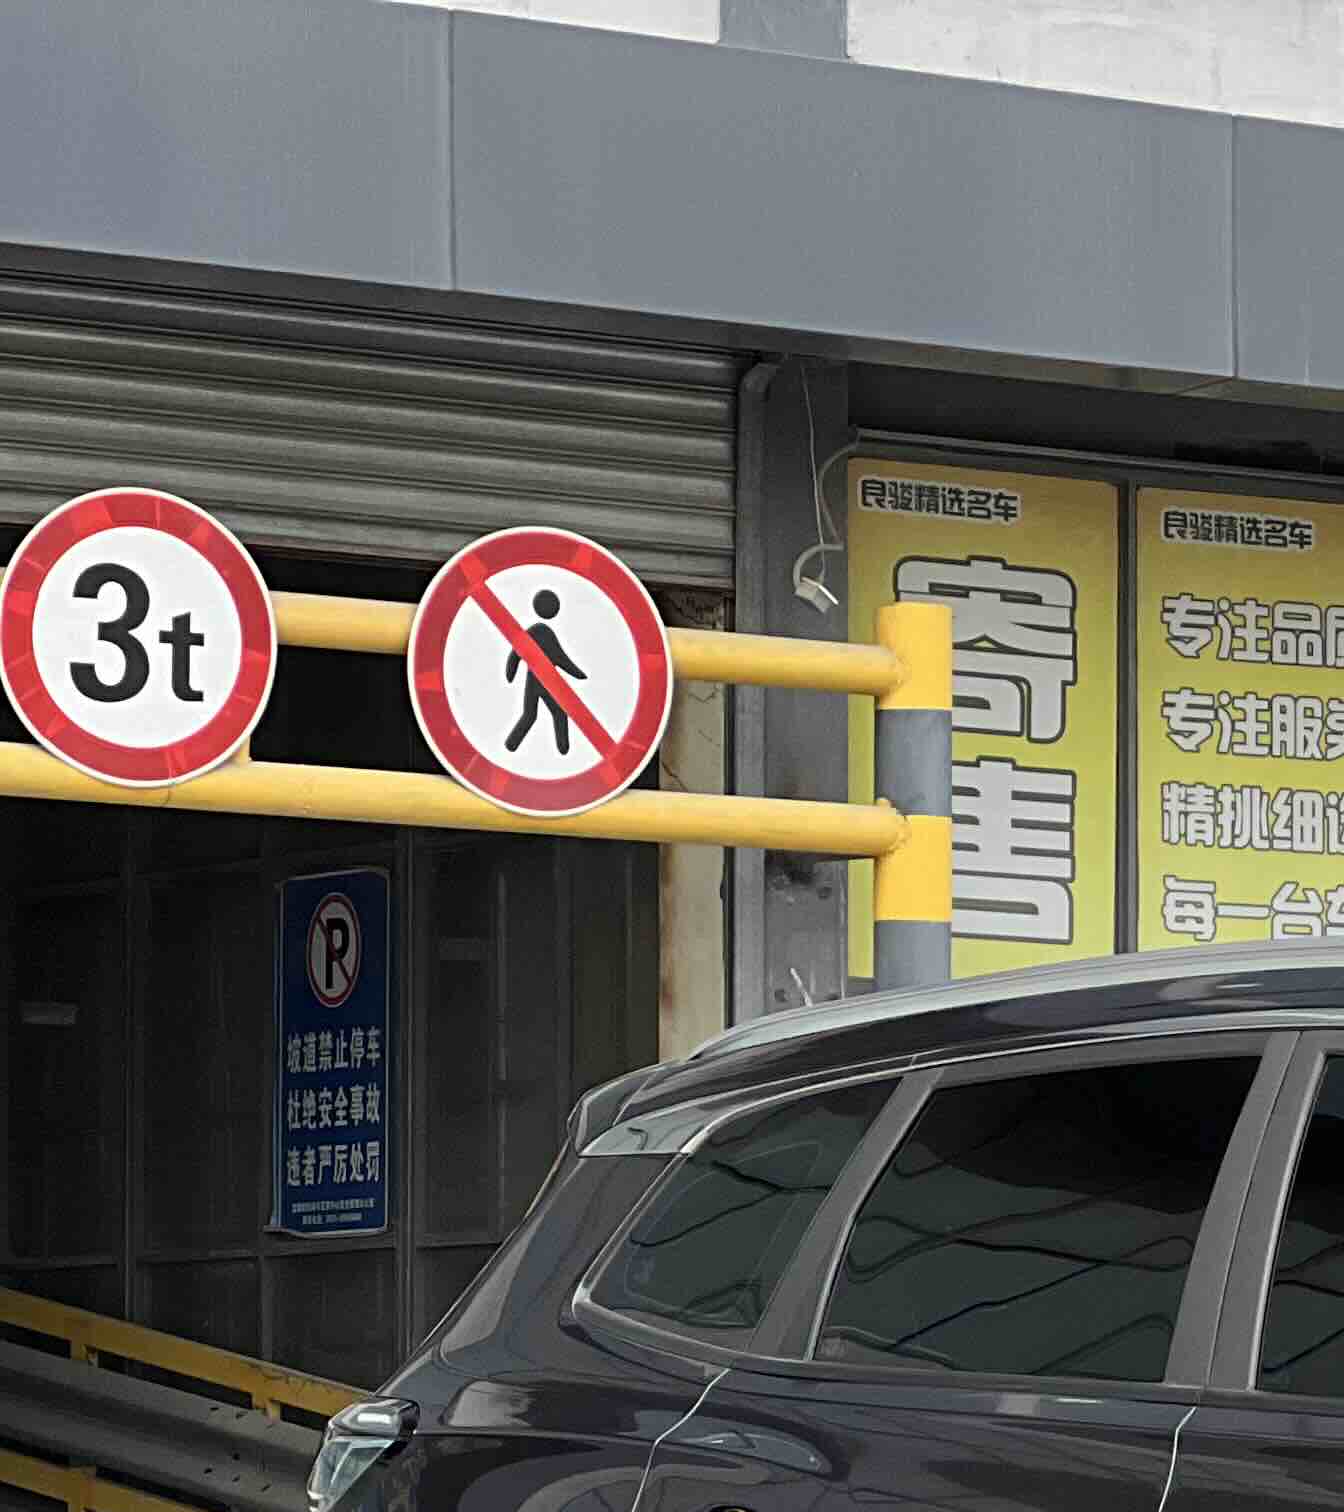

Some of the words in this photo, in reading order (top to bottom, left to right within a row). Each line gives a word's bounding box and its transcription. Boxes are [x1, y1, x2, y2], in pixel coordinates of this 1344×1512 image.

[860, 479, 1019, 523] 良骏精选名车
[1163, 510, 1313, 550] 良骏精选名车
[69, 562, 205, 703] 3t
[287, 1025, 381, 1073] 坡道禁止停车
[287, 1082, 381, 1131] 杜绝安全事故
[287, 1141, 381, 1187] 违者严厉处罚
